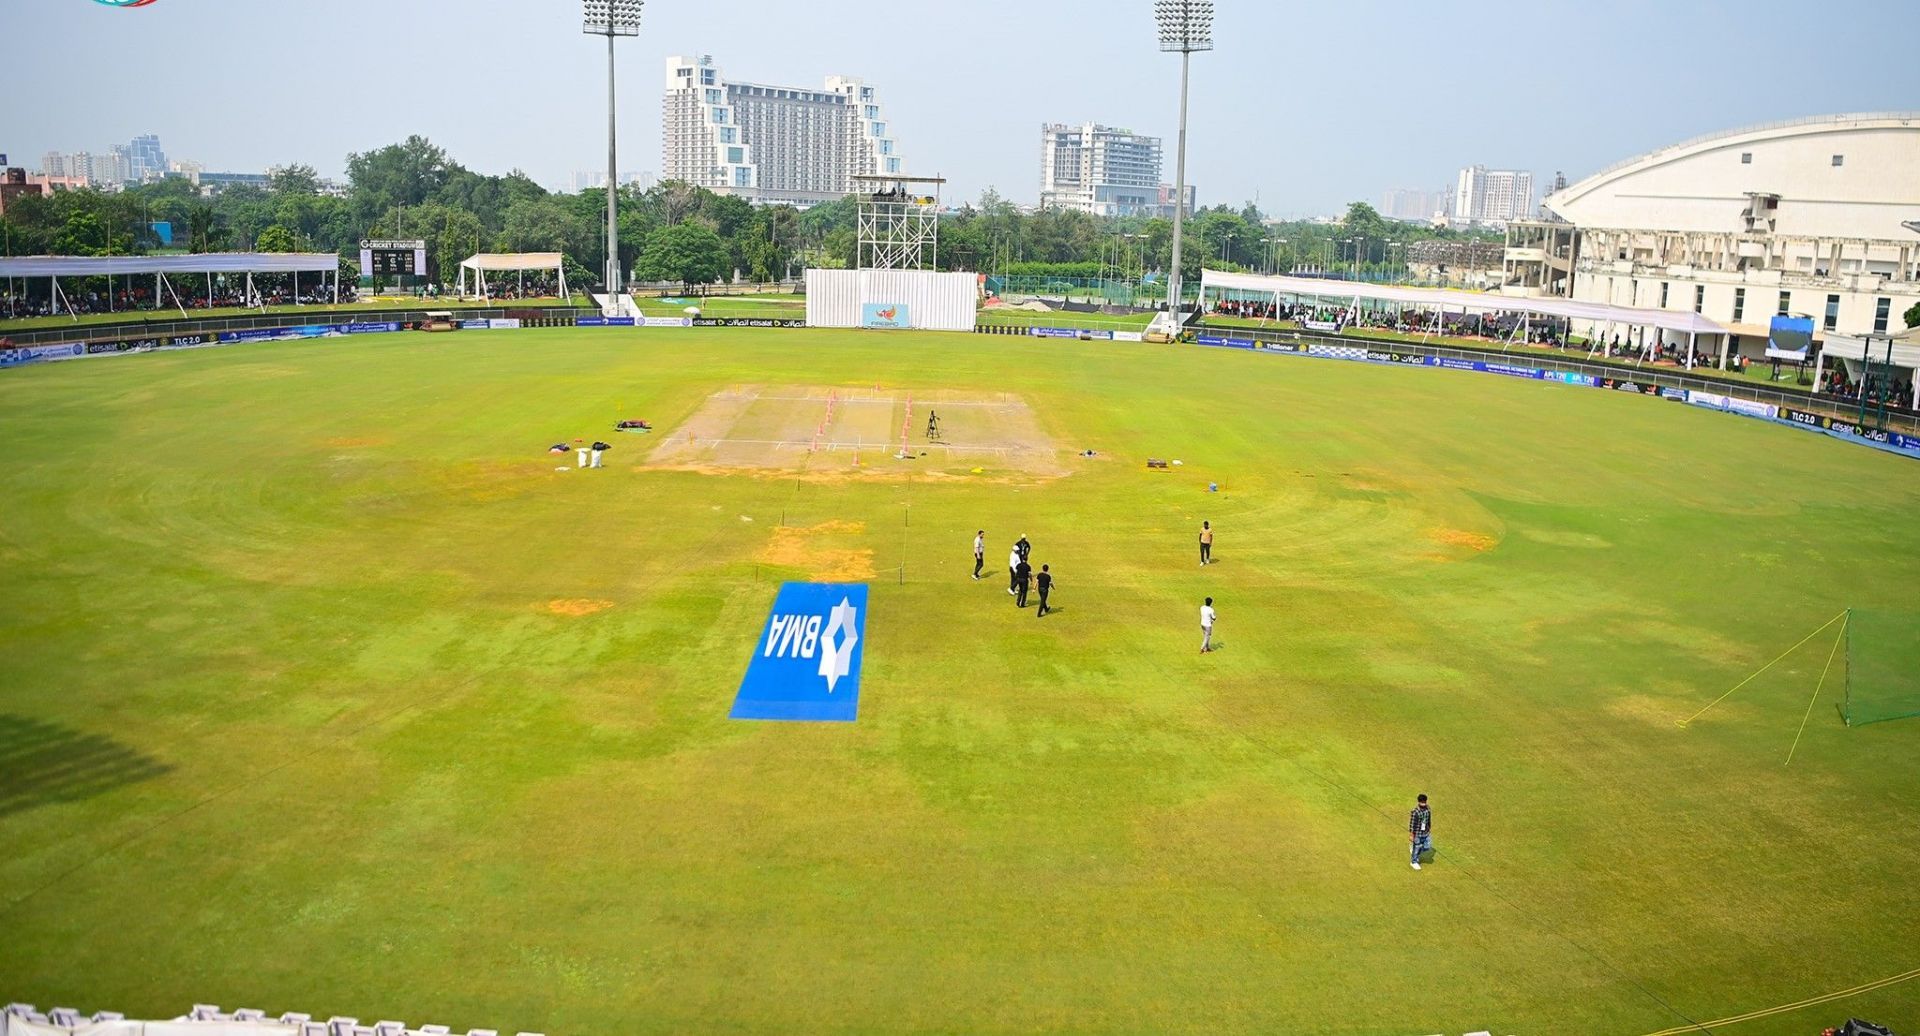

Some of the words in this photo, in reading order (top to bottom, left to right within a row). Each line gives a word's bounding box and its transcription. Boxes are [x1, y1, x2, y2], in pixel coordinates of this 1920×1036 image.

[175, 337, 188, 346] TLC
[189, 336, 200, 344] 2.0
[89, 342, 118, 353] etisalat
[1367, 352, 1391, 361] etisalat
[1401, 355, 1424, 364] اتصالات
[1791, 411, 1804, 422] TLC
[1804, 414, 1815, 424] 2.0
[1831, 422, 1855, 434] etisalat
[1864, 430, 1887, 442] اتصالات
[764, 614, 822, 658] BMA
